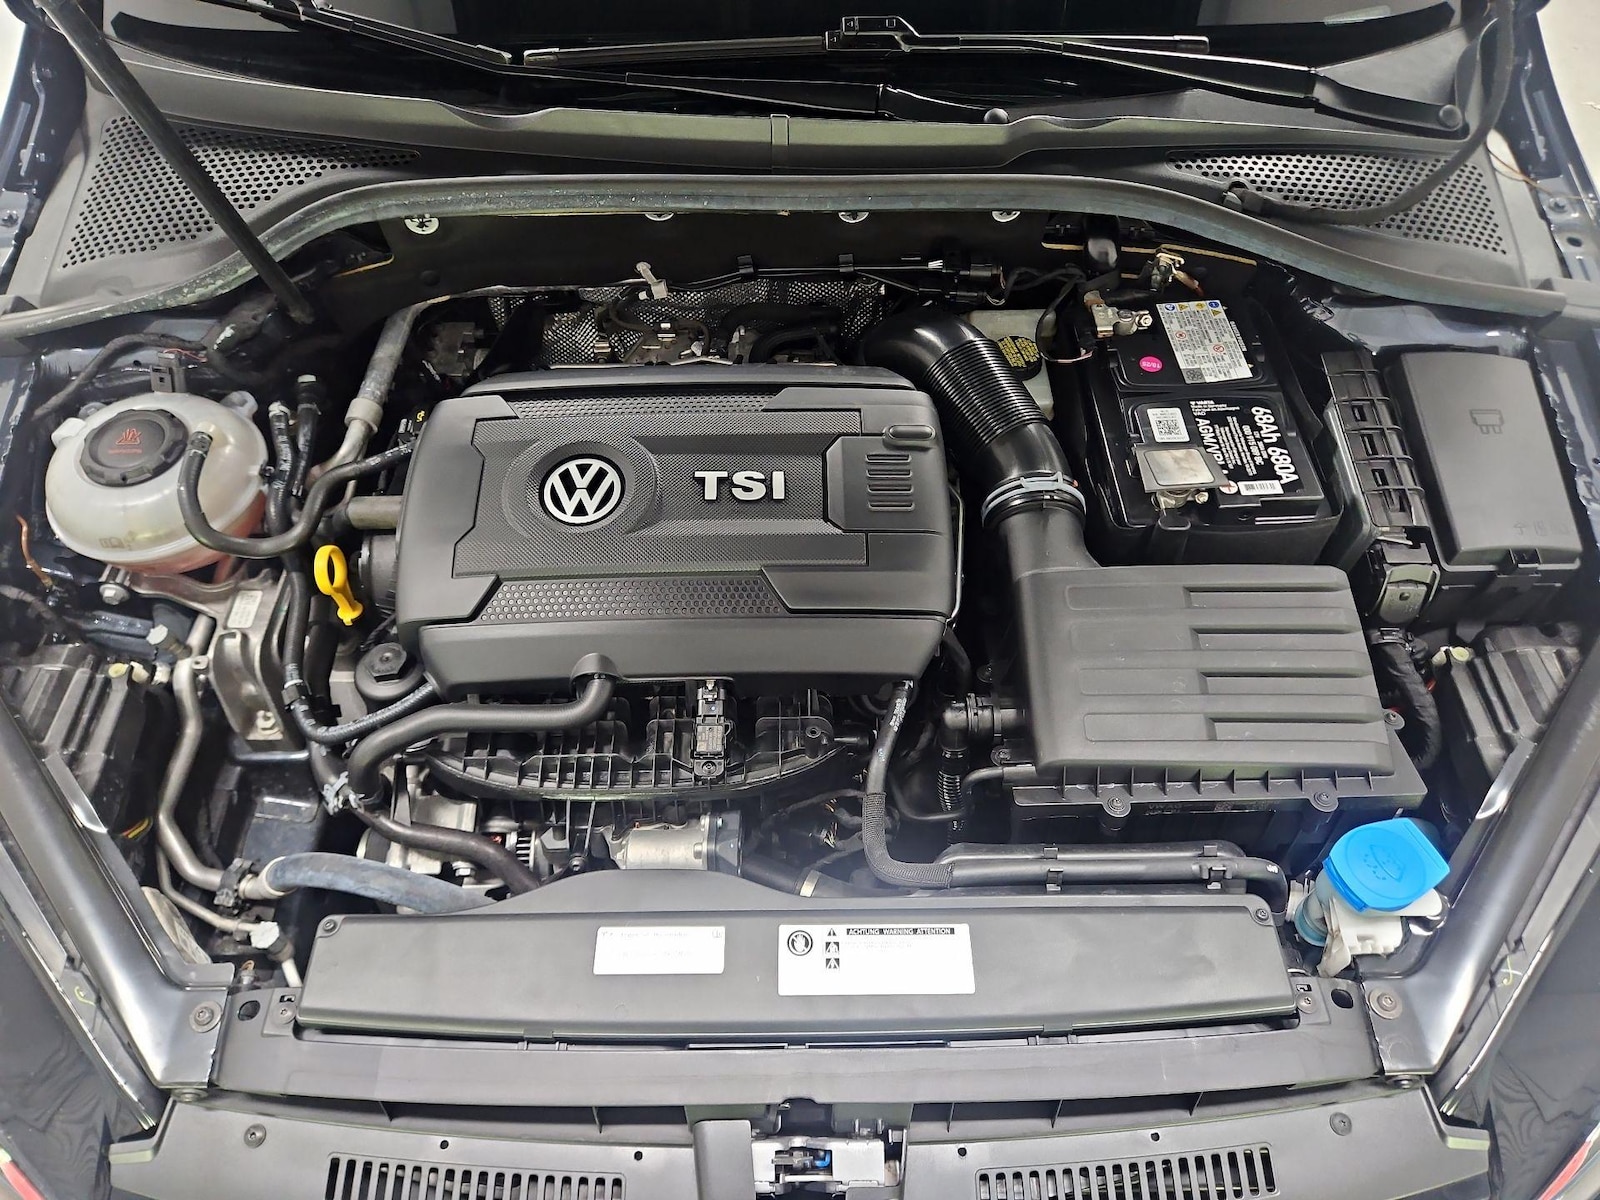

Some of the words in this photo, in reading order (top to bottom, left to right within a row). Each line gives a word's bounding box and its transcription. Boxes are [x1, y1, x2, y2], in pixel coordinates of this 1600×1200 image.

[1251, 406, 1281, 443] 68Ah
[1267, 446, 1299, 484] 680A
[694, 471, 785, 500] TSI
